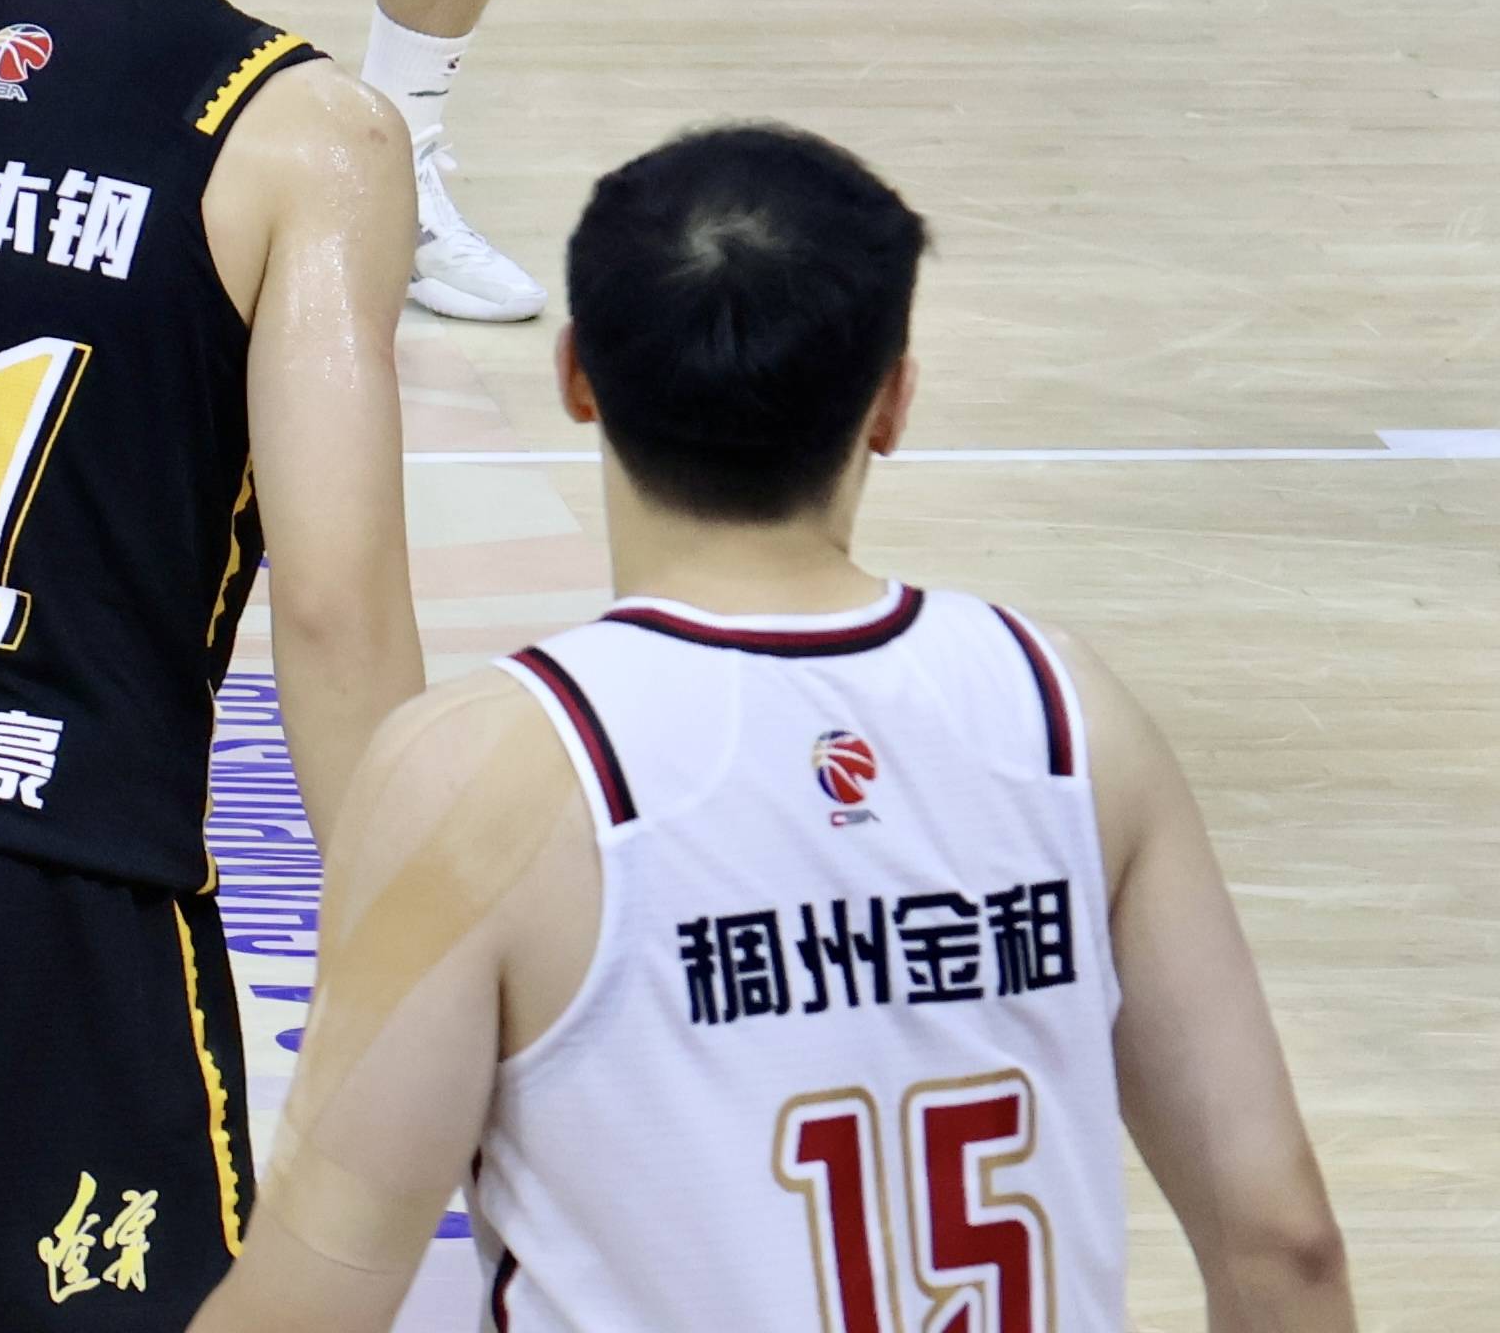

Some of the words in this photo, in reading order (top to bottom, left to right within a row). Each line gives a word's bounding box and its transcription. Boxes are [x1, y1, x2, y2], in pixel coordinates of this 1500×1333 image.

[676, 879, 1078, 1026] 稠州金租
[770, 1067, 1056, 1333] 15
